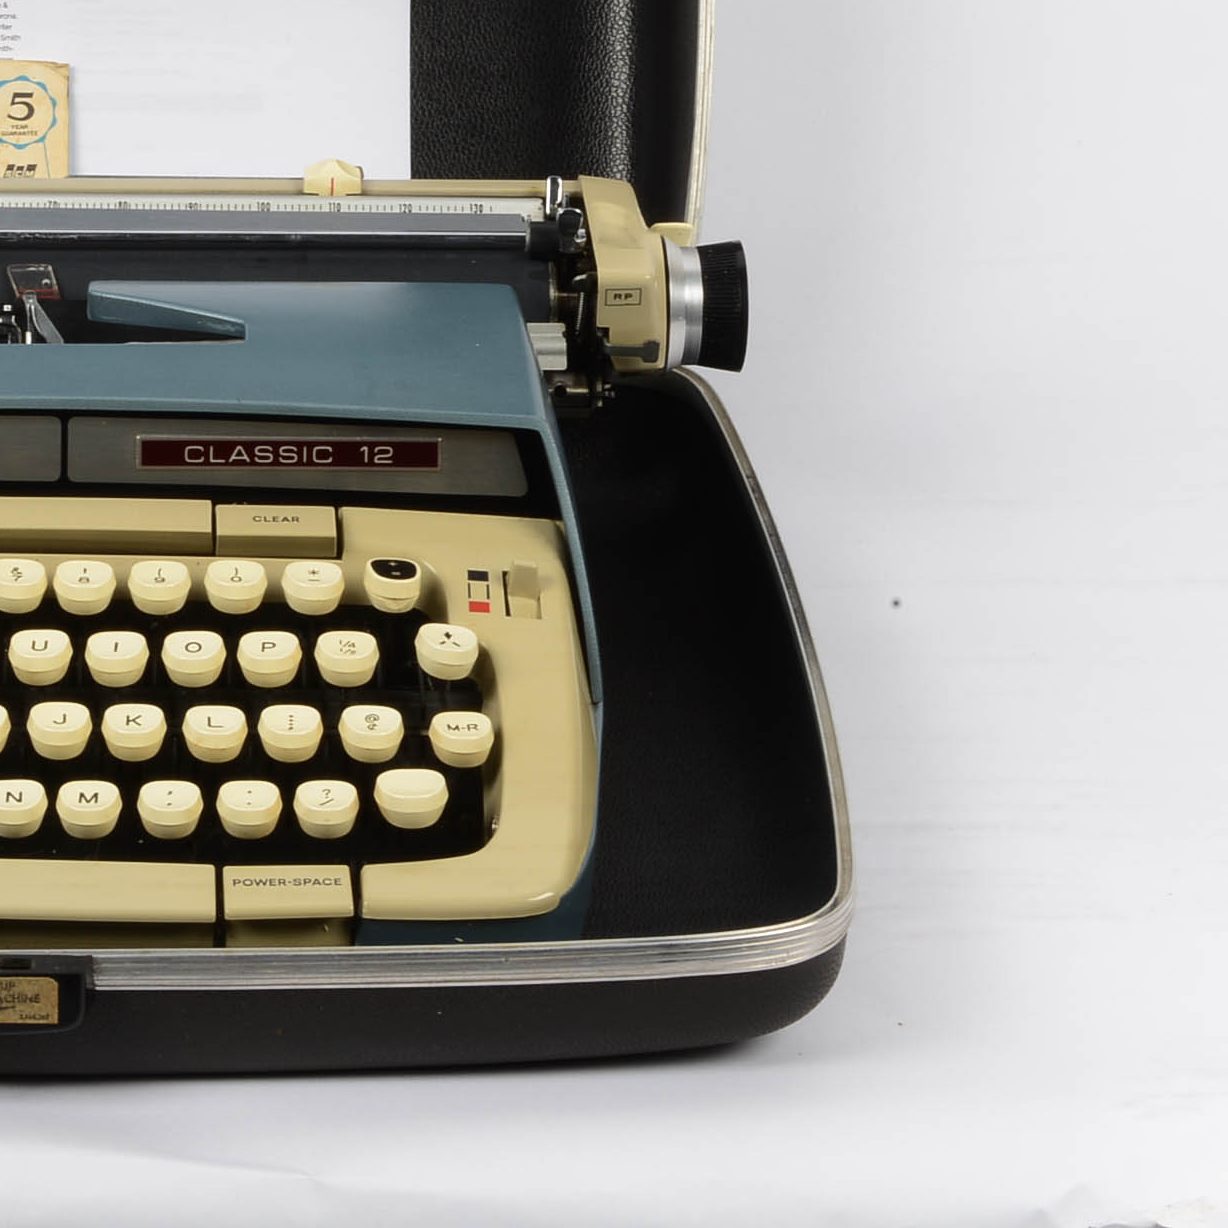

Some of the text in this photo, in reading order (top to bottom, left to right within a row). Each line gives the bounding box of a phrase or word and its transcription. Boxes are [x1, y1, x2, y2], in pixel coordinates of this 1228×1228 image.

[7, 92, 35, 121] 5
[257, 202, 484, 214] 100 110 120 130
[613, 292, 634, 301] RP
[184, 445, 394, 464] CLASSIC 12
[32, 640, 48, 652] U
[114, 642, 118, 652] I
[185, 642, 202, 653] O
[261, 642, 276, 652] P
[53, 714, 67, 725] J
[125, 715, 142, 726] K
[207, 716, 224, 728] L
[365, 713, 379, 723] @
[446, 723, 478, 732] M-R
[6, 792, 22, 803] N
[78, 792, 99, 803] M
[232, 878, 342, 887] POWER-SPACE
